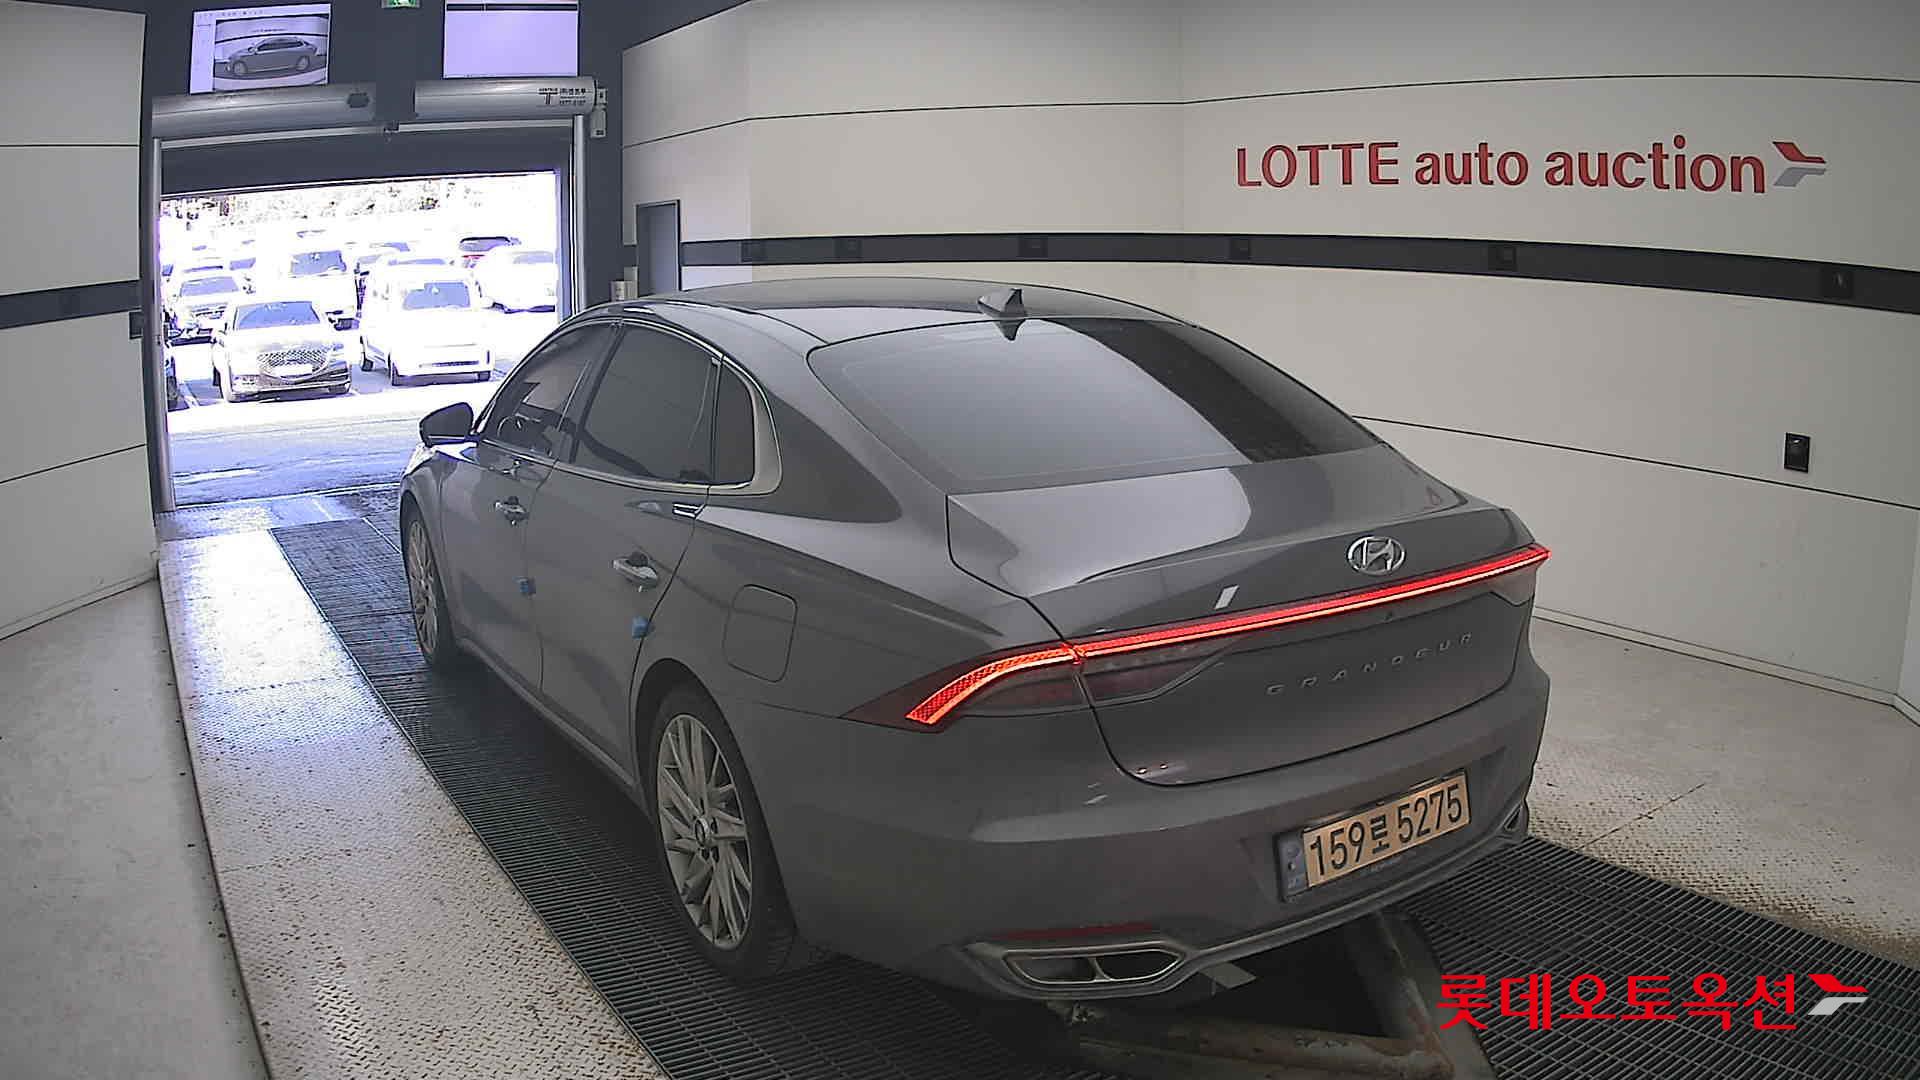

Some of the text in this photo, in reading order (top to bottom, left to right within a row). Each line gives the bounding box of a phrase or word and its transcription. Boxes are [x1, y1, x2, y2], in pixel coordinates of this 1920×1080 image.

[1237, 135, 1765, 193] LOTTE auto auction
[1266, 632, 1472, 695] GRANDEUR
[1397, 784, 1462, 843] 5275
